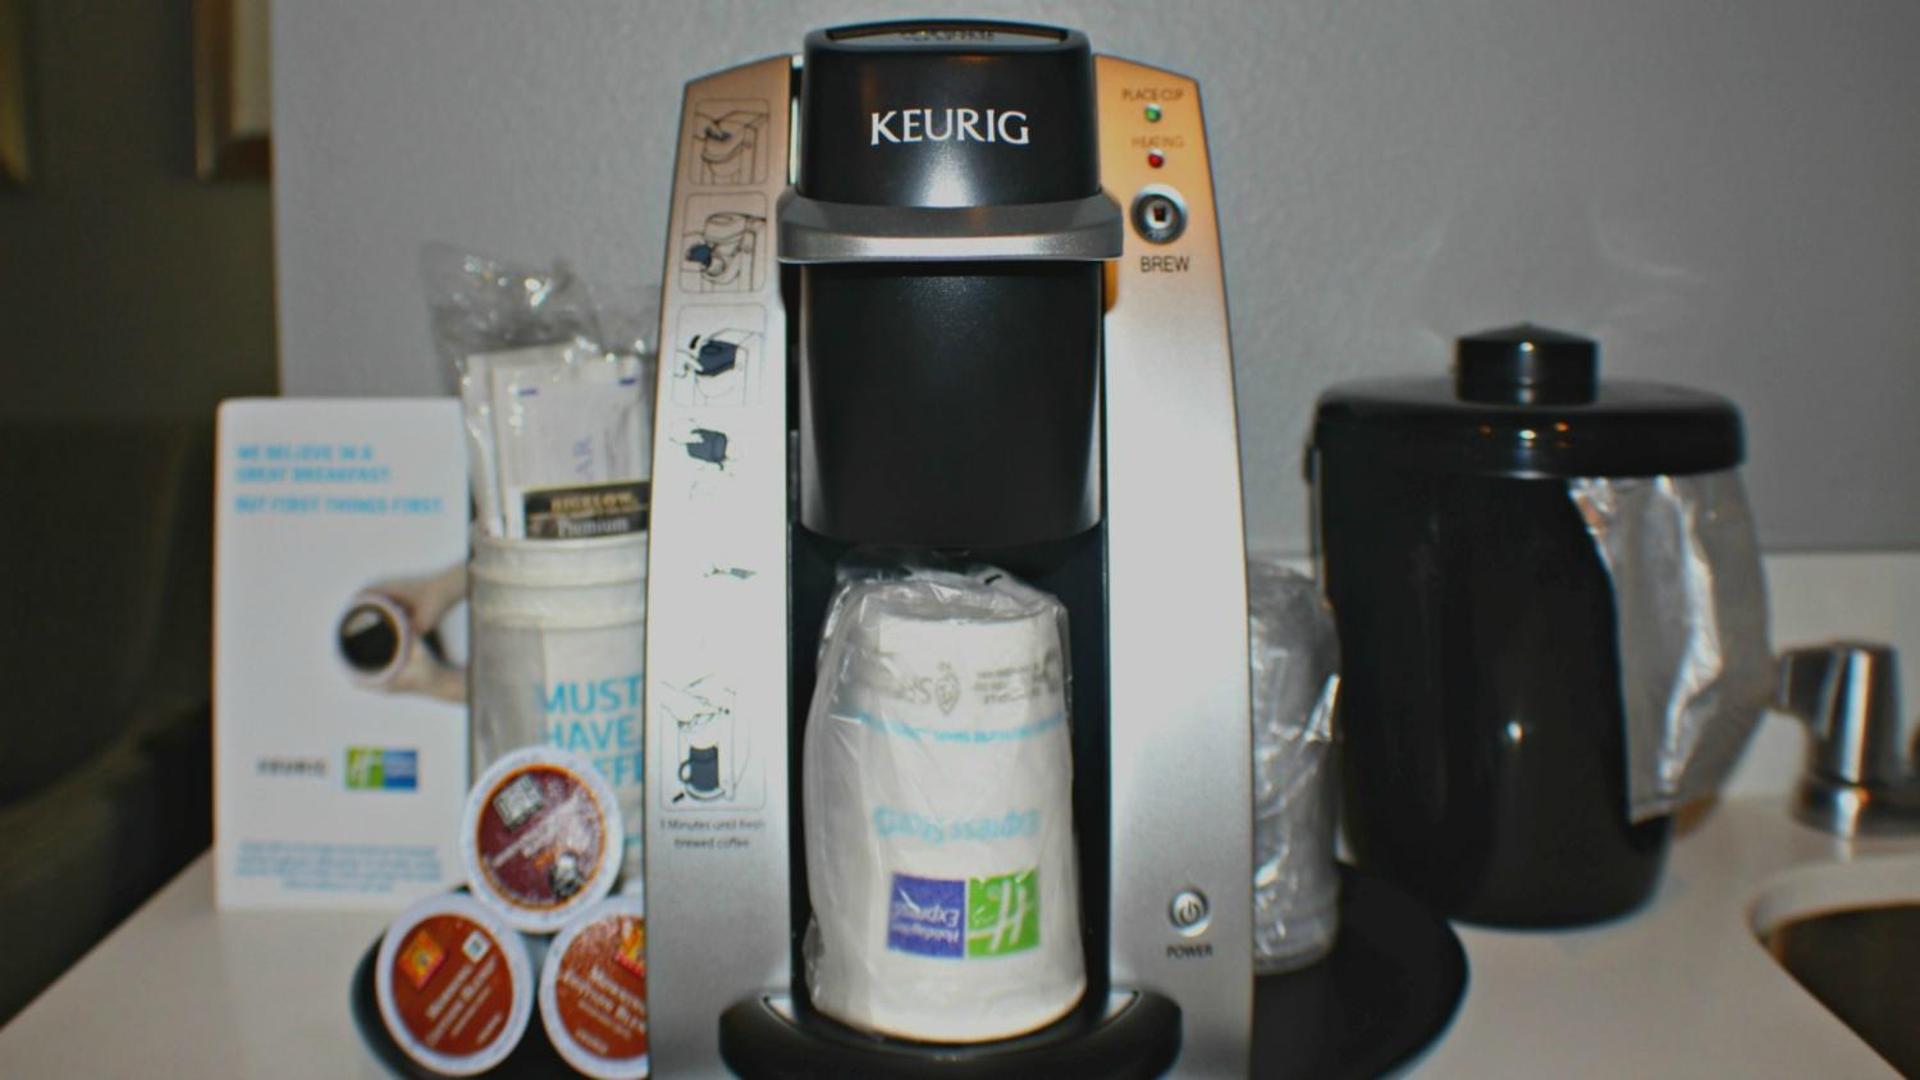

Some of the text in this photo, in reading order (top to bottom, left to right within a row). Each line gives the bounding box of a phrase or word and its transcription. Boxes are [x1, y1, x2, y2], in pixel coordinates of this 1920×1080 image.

[1122, 88, 1184, 101] PLACE CUP
[870, 108, 1030, 145] KEURIG
[1131, 136, 1185, 148] HEATING
[1140, 256, 1190, 273] BREW
[557, 517, 629, 538] Premium
[533, 674, 643, 714] MUST
[542, 715, 636, 752] HAVE
[667, 819, 710, 830] Minutes
[673, 837, 750, 849] brewed coffee
[1166, 943, 1213, 958] POWER
